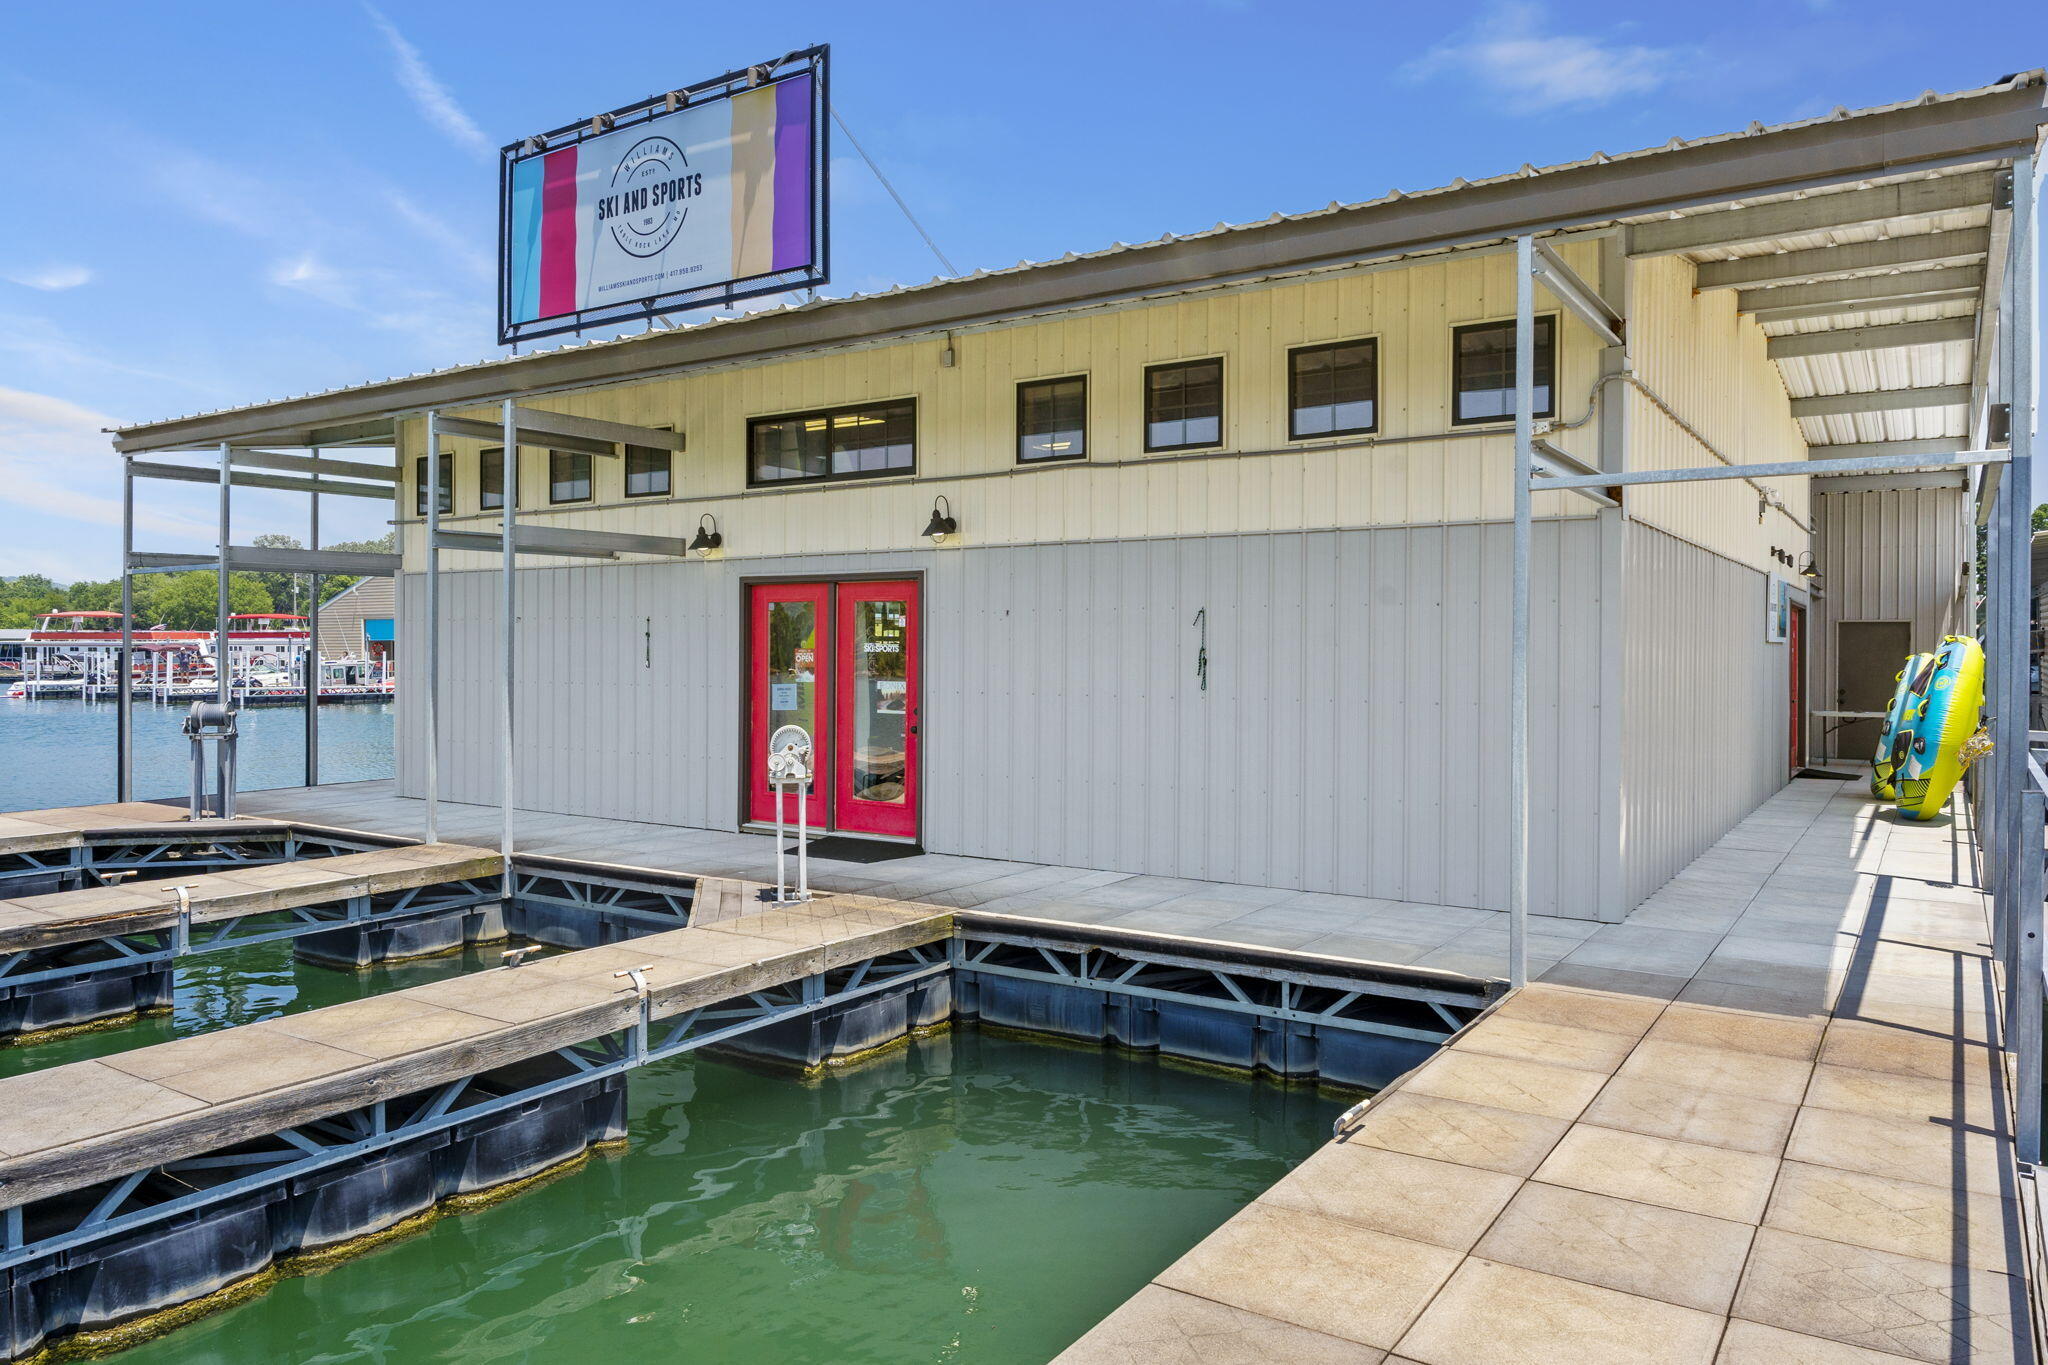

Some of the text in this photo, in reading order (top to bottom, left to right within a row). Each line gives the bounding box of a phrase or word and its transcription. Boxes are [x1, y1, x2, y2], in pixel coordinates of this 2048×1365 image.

[624, 144, 675, 172] WILLIAMS
[598, 172, 702, 221] SKI AND SPORTS
[795, 654, 814, 663] OPEN
